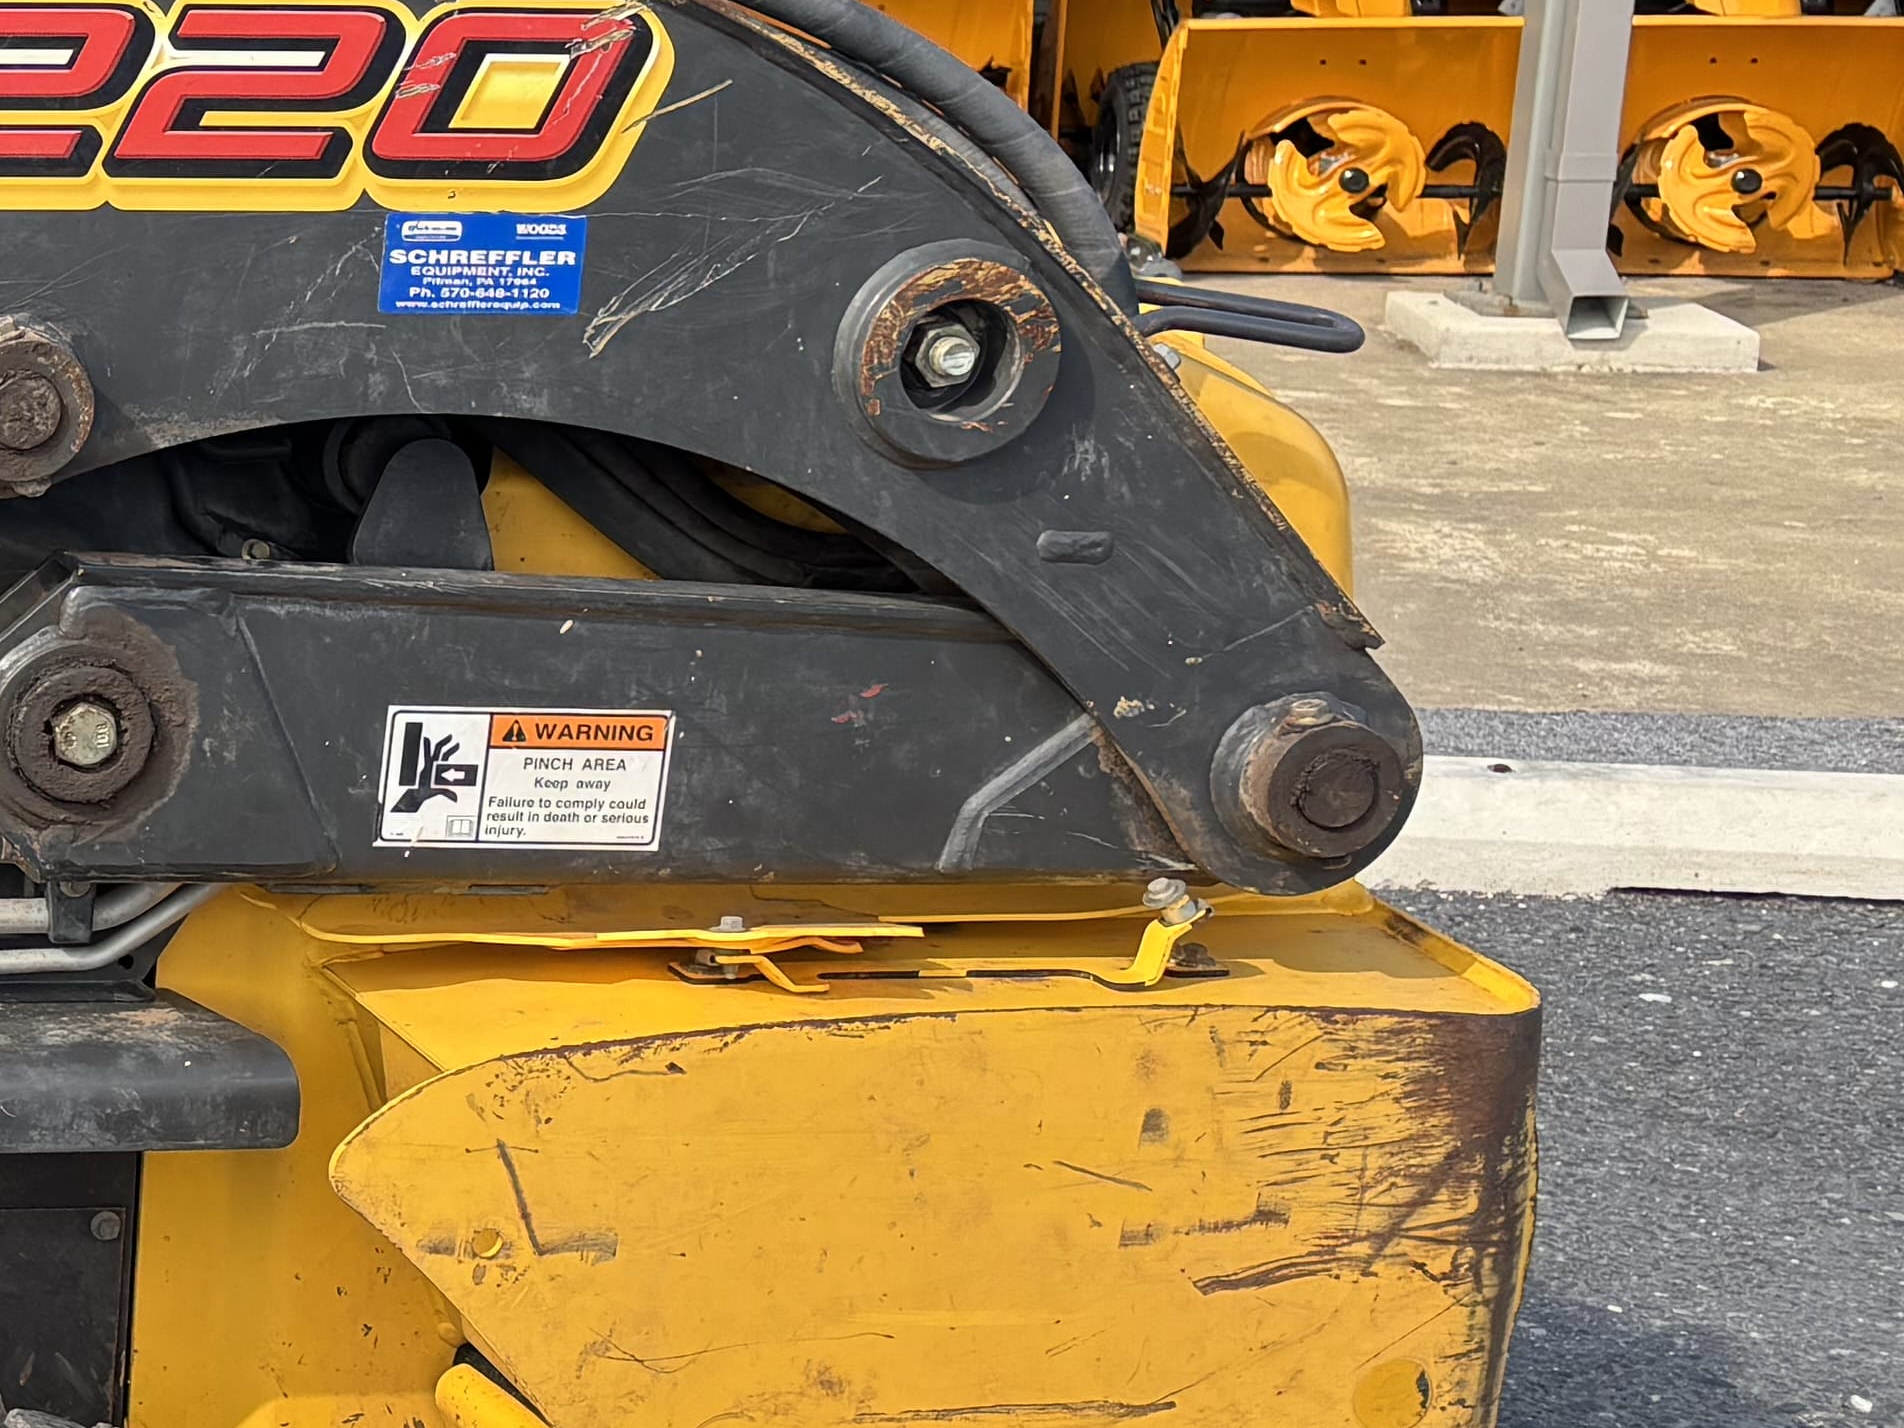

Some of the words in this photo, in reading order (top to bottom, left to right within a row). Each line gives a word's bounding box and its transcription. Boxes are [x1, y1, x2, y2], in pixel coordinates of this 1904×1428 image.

[389, 249, 576, 265] SCHREFFLER
[517, 267, 550, 277] INC.
[476, 278, 495, 286] PA
[409, 287, 436, 298] Ph.
[535, 723, 654, 742] WARNING
[523, 757, 573, 771] PINCH
[582, 758, 627, 772] AREA
[534, 777, 568, 792] Keep
[576, 779, 611, 792] away
[488, 796, 535, 809] Failure
[539, 796, 551, 809] to
[555, 798, 605, 812] comply
[608, 797, 646, 810] could
[486, 810, 524, 822] result
[528, 811, 540, 822] in
[543, 811, 580, 823] death
[583, 813, 597, 824] or
[601, 812, 649, 824] serious
[484, 824, 527, 837] injury.
